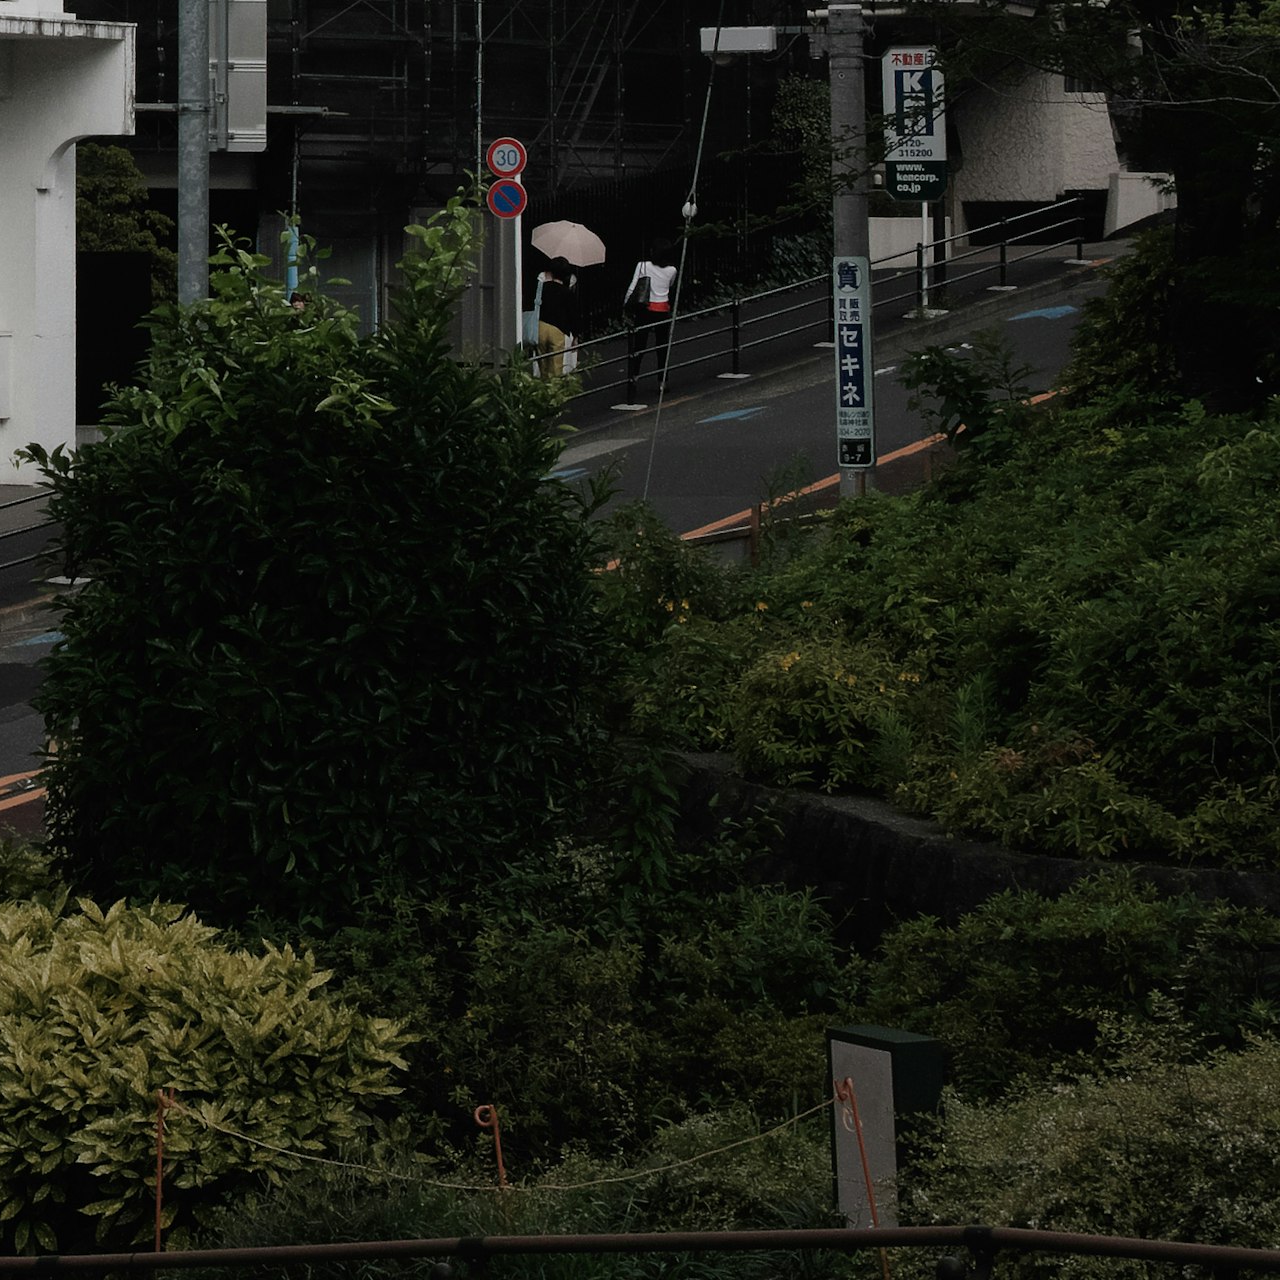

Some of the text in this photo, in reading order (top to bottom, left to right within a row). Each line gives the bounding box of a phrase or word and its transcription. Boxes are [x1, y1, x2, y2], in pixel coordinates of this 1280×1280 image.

[496, 150, 517, 166] 30
[898, 149, 933, 157] 315200
[896, 173, 939, 182] kencorp.
[896, 182, 921, 193] co.jp
[837, 261, 859, 290] 質
[840, 325, 861, 406] セキネ
